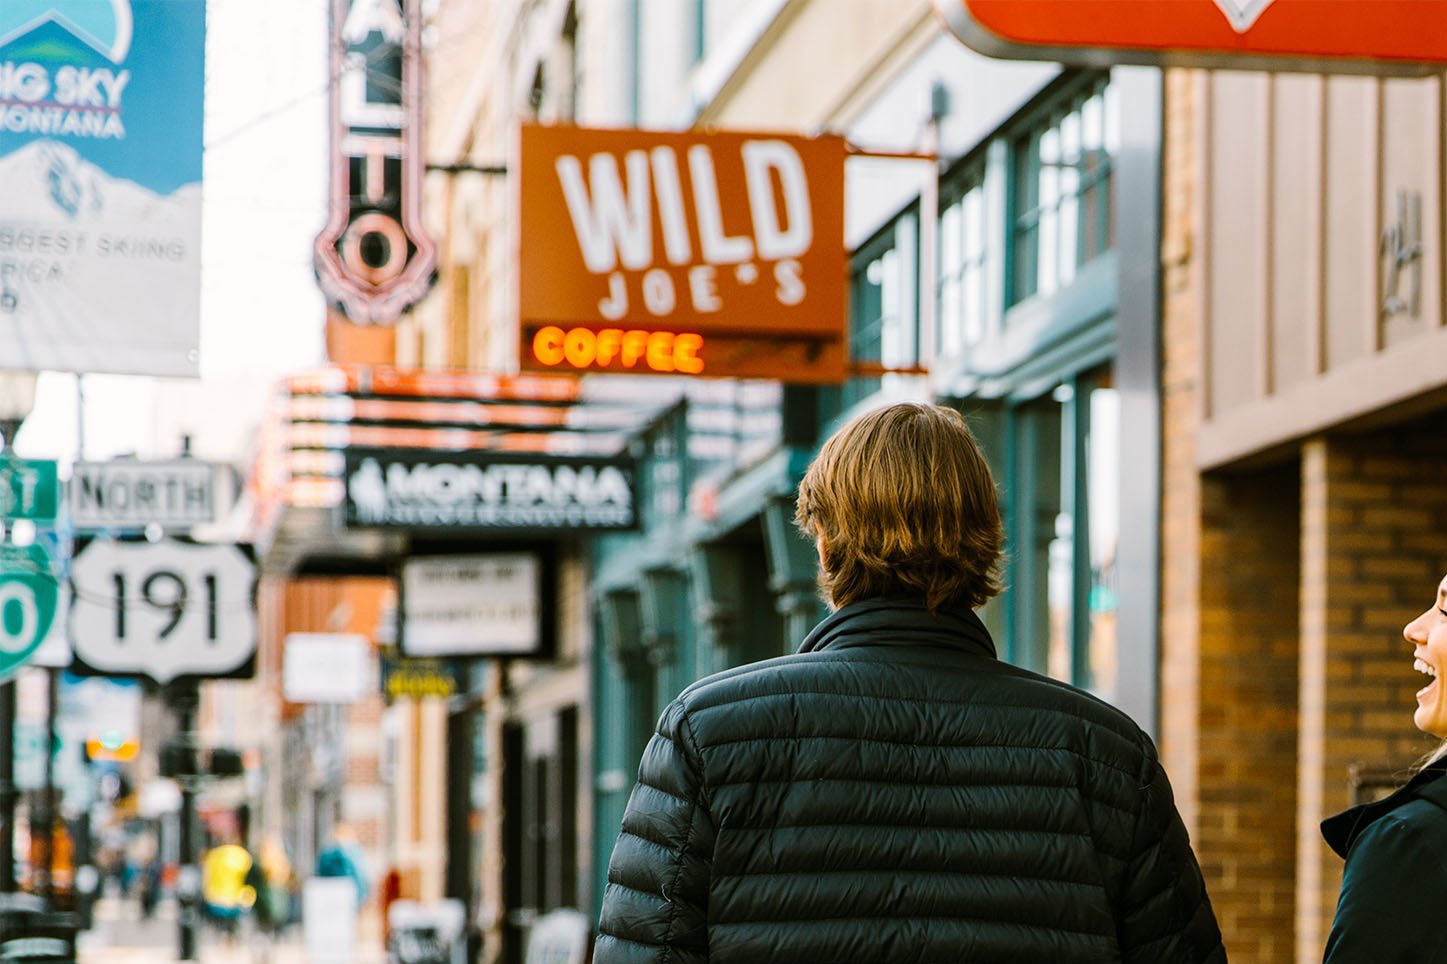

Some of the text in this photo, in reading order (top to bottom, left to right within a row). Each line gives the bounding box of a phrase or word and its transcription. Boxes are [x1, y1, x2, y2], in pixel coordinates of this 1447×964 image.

[54, 64, 131, 109] SKY
[554, 138, 814, 274] WILD
[96, 231, 186, 262] SKIING
[597, 258, 806, 321] JOE'S
[532, 325, 705, 374] COFFEE
[78, 468, 210, 510] NORTH
[386, 461, 634, 503] MONTANA
[112, 569, 218, 643] 191
